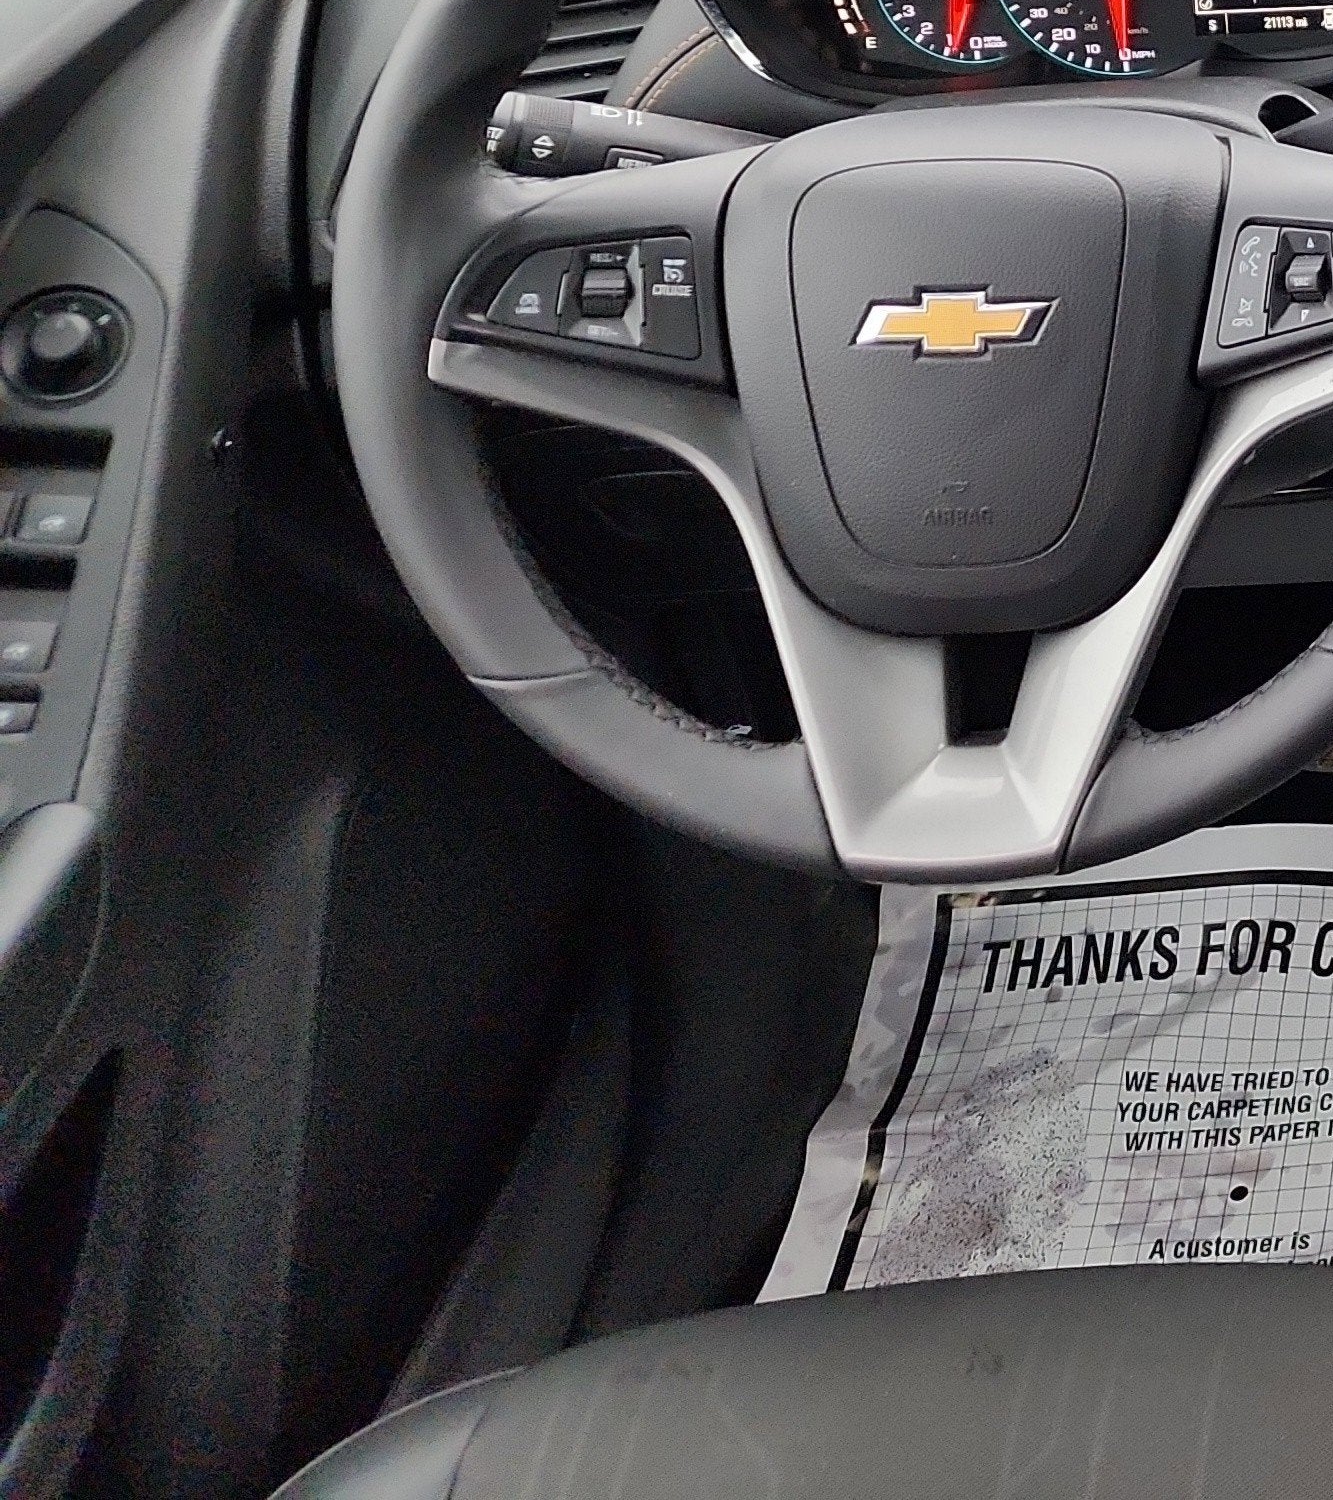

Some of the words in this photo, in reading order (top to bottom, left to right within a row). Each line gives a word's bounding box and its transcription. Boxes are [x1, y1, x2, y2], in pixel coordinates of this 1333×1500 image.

[902, 5, 915, 18] 3
[1029, 7, 1048, 19] 30
[920, 22, 934, 34] 2
[1208, 20, 1218, 32] S
[1264, 16, 1294, 29] 21113
[1295, 16, 1309, 28] mi
[1051, 28, 1077, 41] 20
[865, 37, 877, 49] E
[970, 37, 983, 49] 0
[1085, 44, 1100, 54] 10
[1131, 50, 1156, 59] MPH
[982, 926, 1179, 993] THANKS
[1197, 918, 1291, 975] FOR
[1124, 1070, 1159, 1093] WE
[1166, 1069, 1224, 1092] HAVE
[1230, 1067, 1294, 1091] TRIED
[1301, 1067, 1330, 1087] TO
[1117, 1100, 1180, 1123] YOUR
[1187, 1095, 1311, 1121] CARPETING
[1124, 1129, 1186, 1152] WITH
[1190, 1126, 1242, 1148] THIS
[1249, 1119, 1320, 1143] PAPER
[1148, 1238, 1165, 1260] A
[1171, 1233, 1284, 1259] customer
[1290, 1231, 1311, 1250] is
